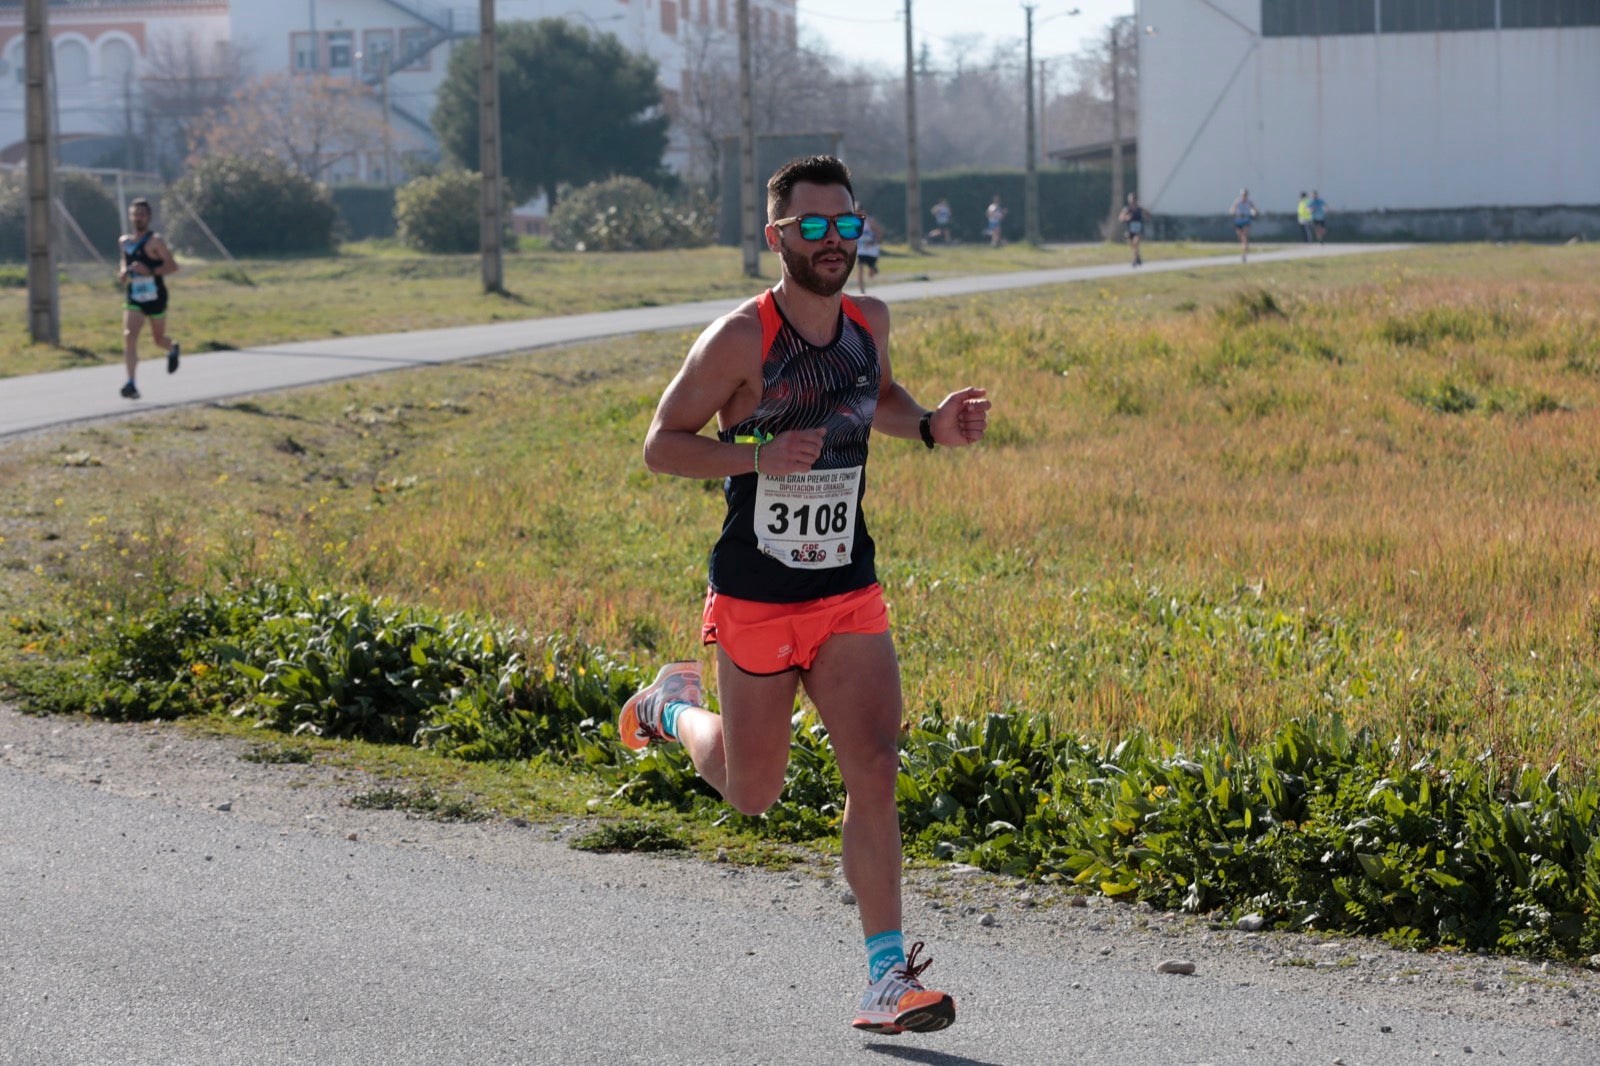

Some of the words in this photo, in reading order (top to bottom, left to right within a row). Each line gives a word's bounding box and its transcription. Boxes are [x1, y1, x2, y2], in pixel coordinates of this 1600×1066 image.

[787, 475, 805, 483] GRAN
[807, 474, 830, 483] PREMIO
[831, 473, 838, 482] DE
[767, 501, 848, 536] 3108
